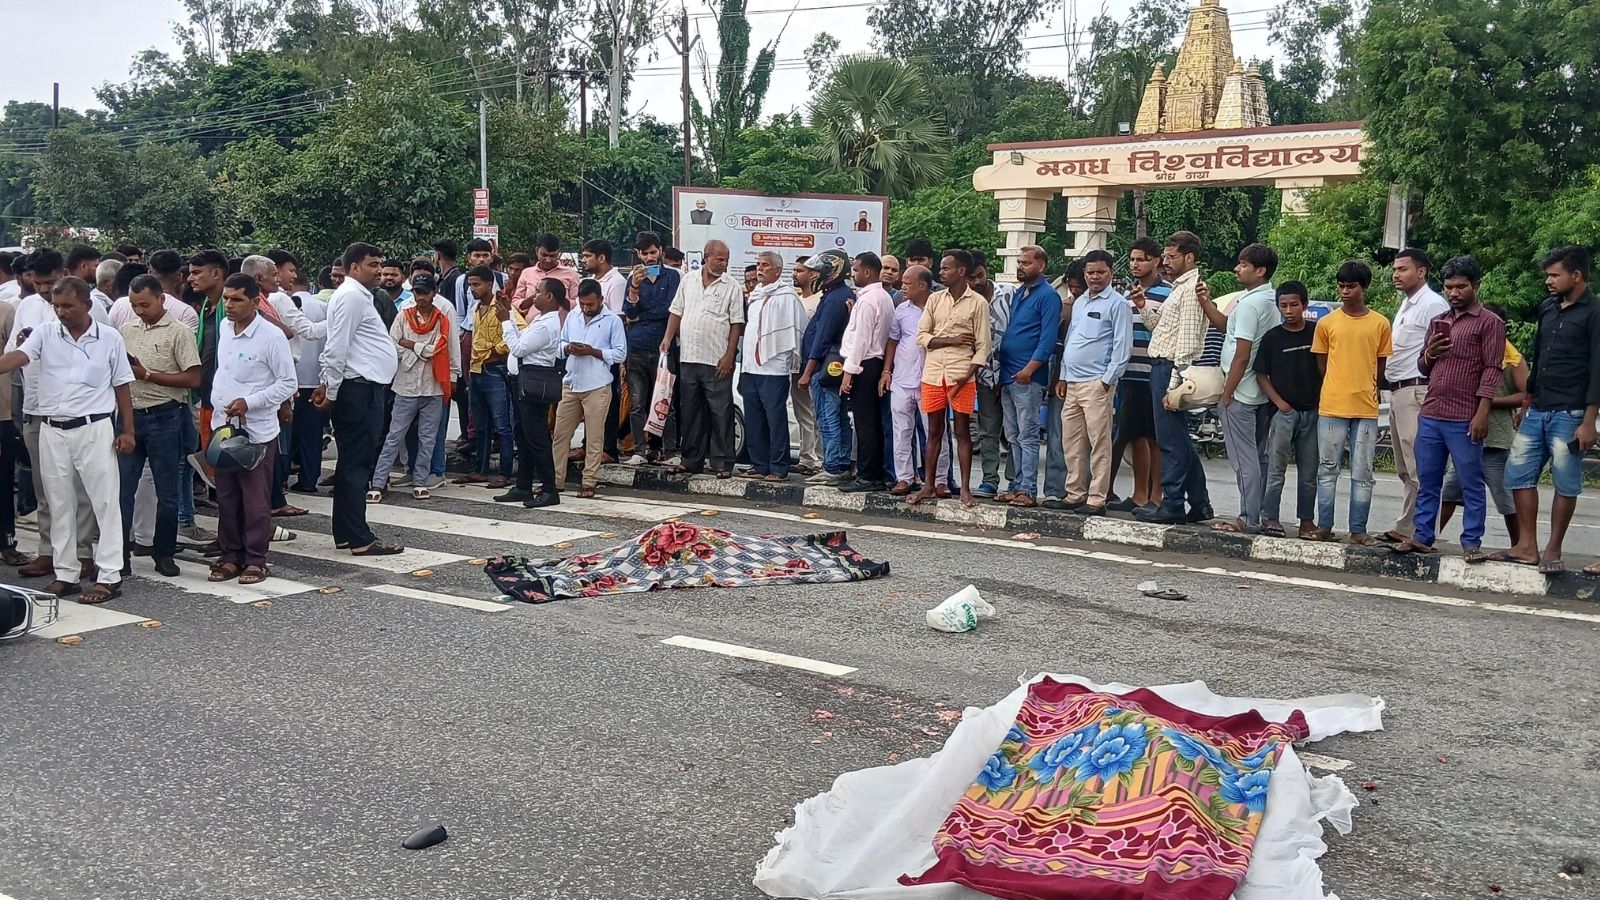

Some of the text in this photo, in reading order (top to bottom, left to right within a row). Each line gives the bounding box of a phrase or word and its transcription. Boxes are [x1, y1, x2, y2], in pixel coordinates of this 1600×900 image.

[1036, 145, 1362, 176] मगध विश्वविद्यालय
[1155, 170, 1209, 180] बोध गया
[741, 216, 834, 230] विद्यार्थी सहयोग पोर्टल
